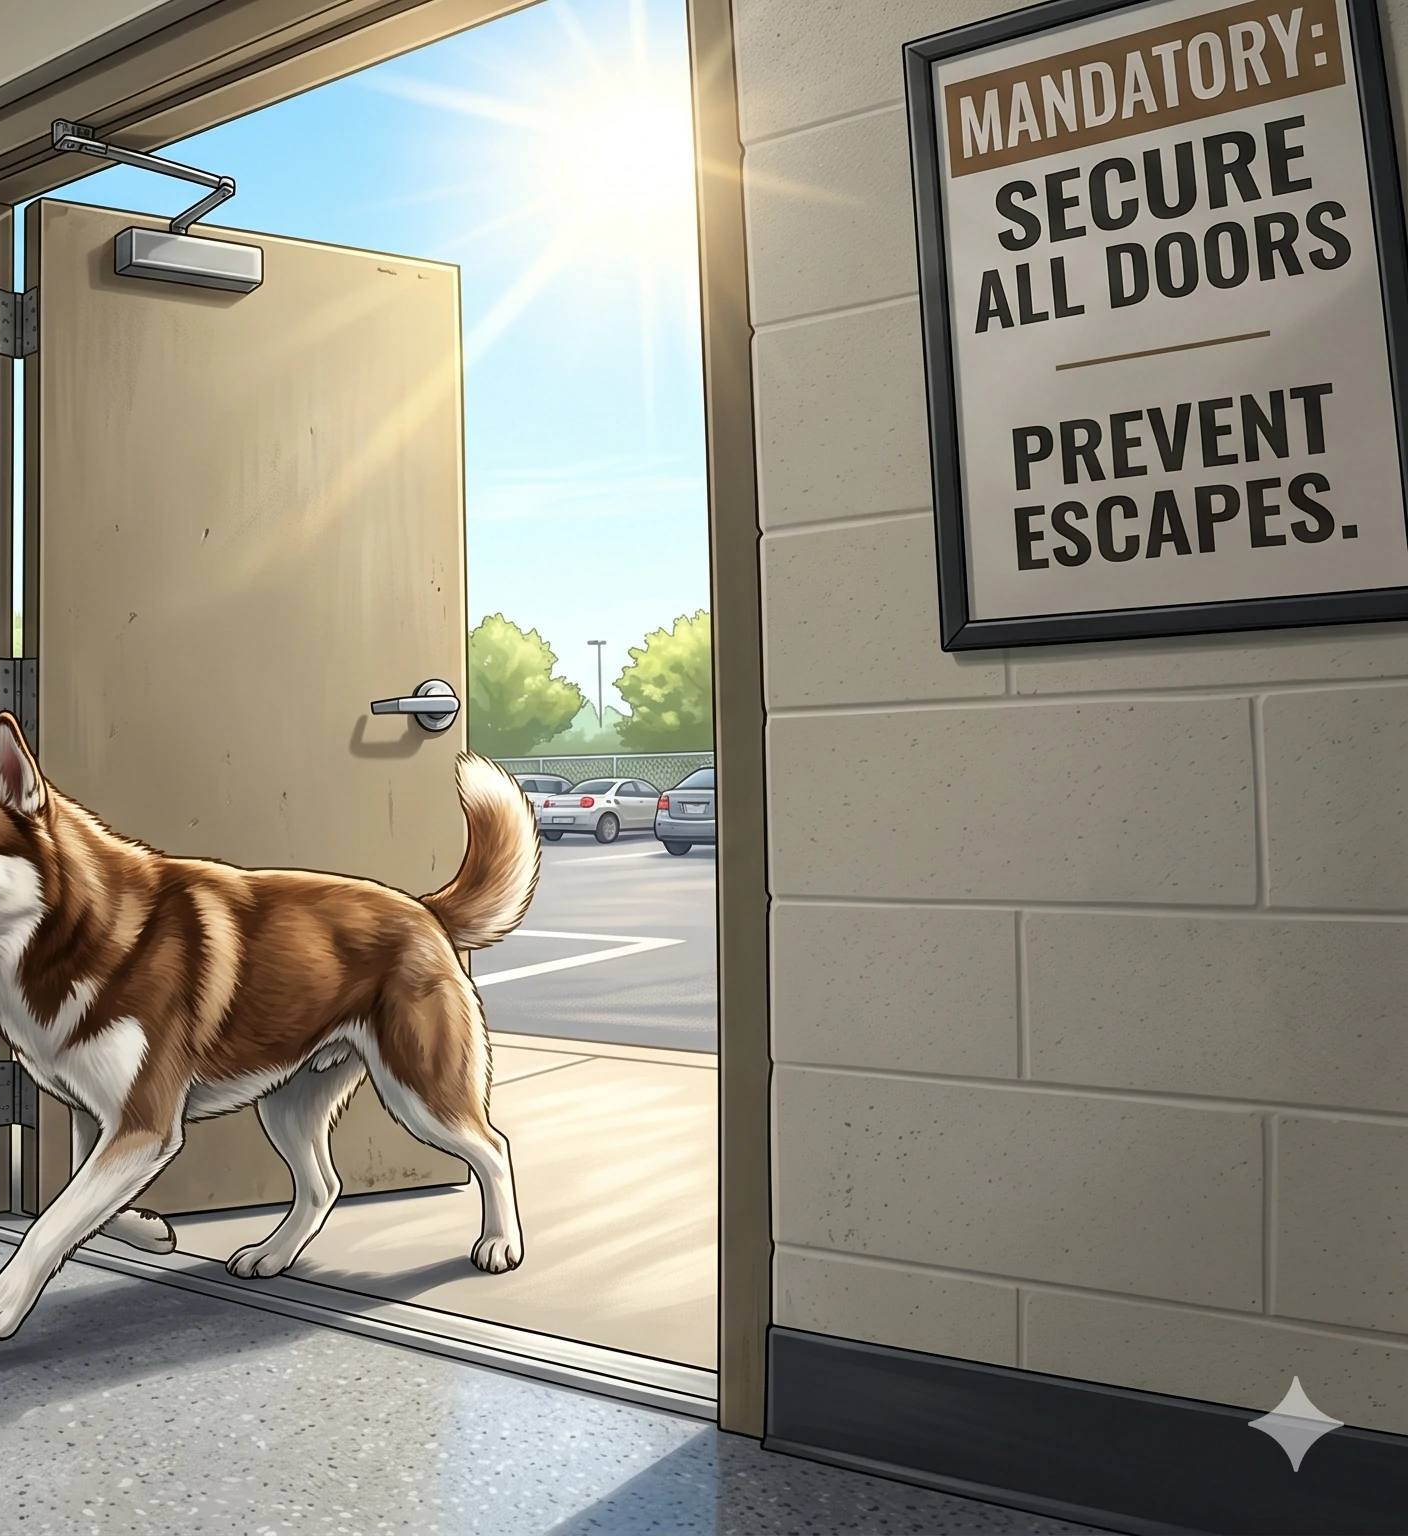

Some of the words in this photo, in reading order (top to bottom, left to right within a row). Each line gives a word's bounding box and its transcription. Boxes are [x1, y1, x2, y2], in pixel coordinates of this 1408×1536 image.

[959, 7, 1329, 160] MANDATORY:
[994, 114, 1313, 253] SECURE
[974, 256, 1085, 334] ALL
[1105, 200, 1352, 310] DOORS
[1011, 382, 1334, 491] PREVENT
[1014, 471, 1359, 571] ESCAPES.
